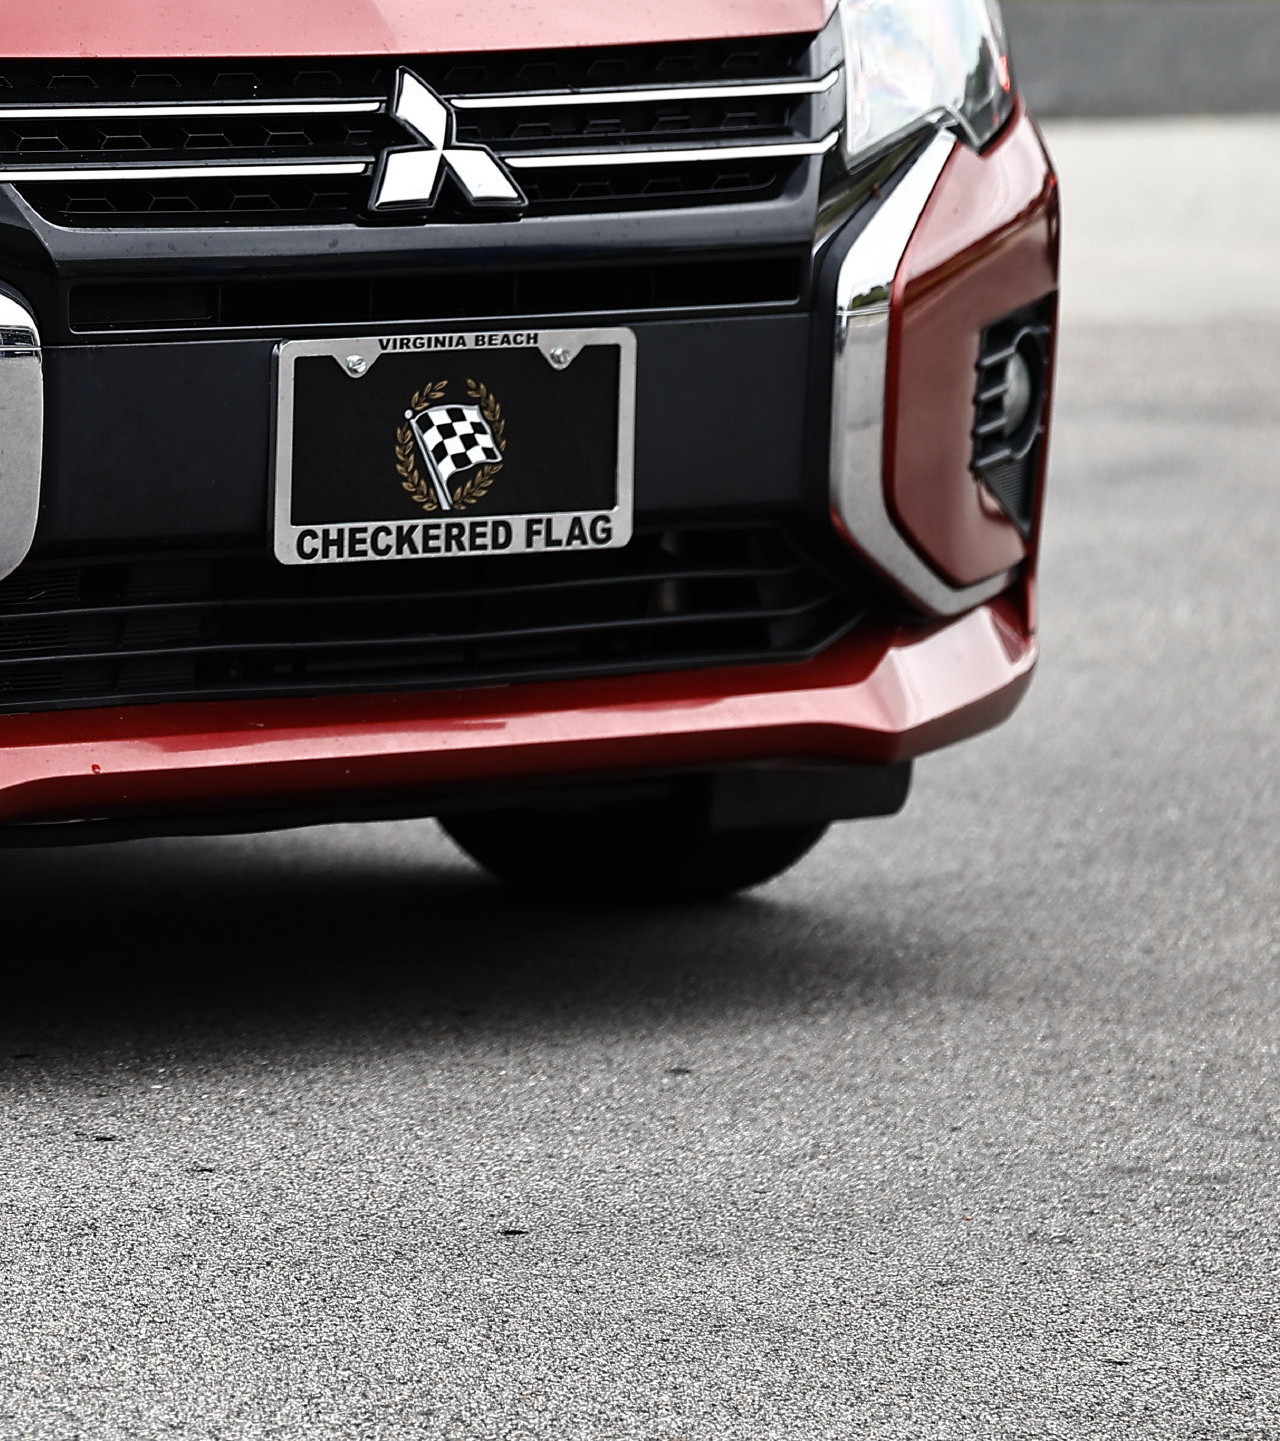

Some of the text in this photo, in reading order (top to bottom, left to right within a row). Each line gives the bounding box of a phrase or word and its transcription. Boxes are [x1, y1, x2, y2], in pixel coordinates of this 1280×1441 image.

[379, 332, 539, 351] VIRGINIA BEACH
[296, 516, 613, 560] CHECKERED FLAG
